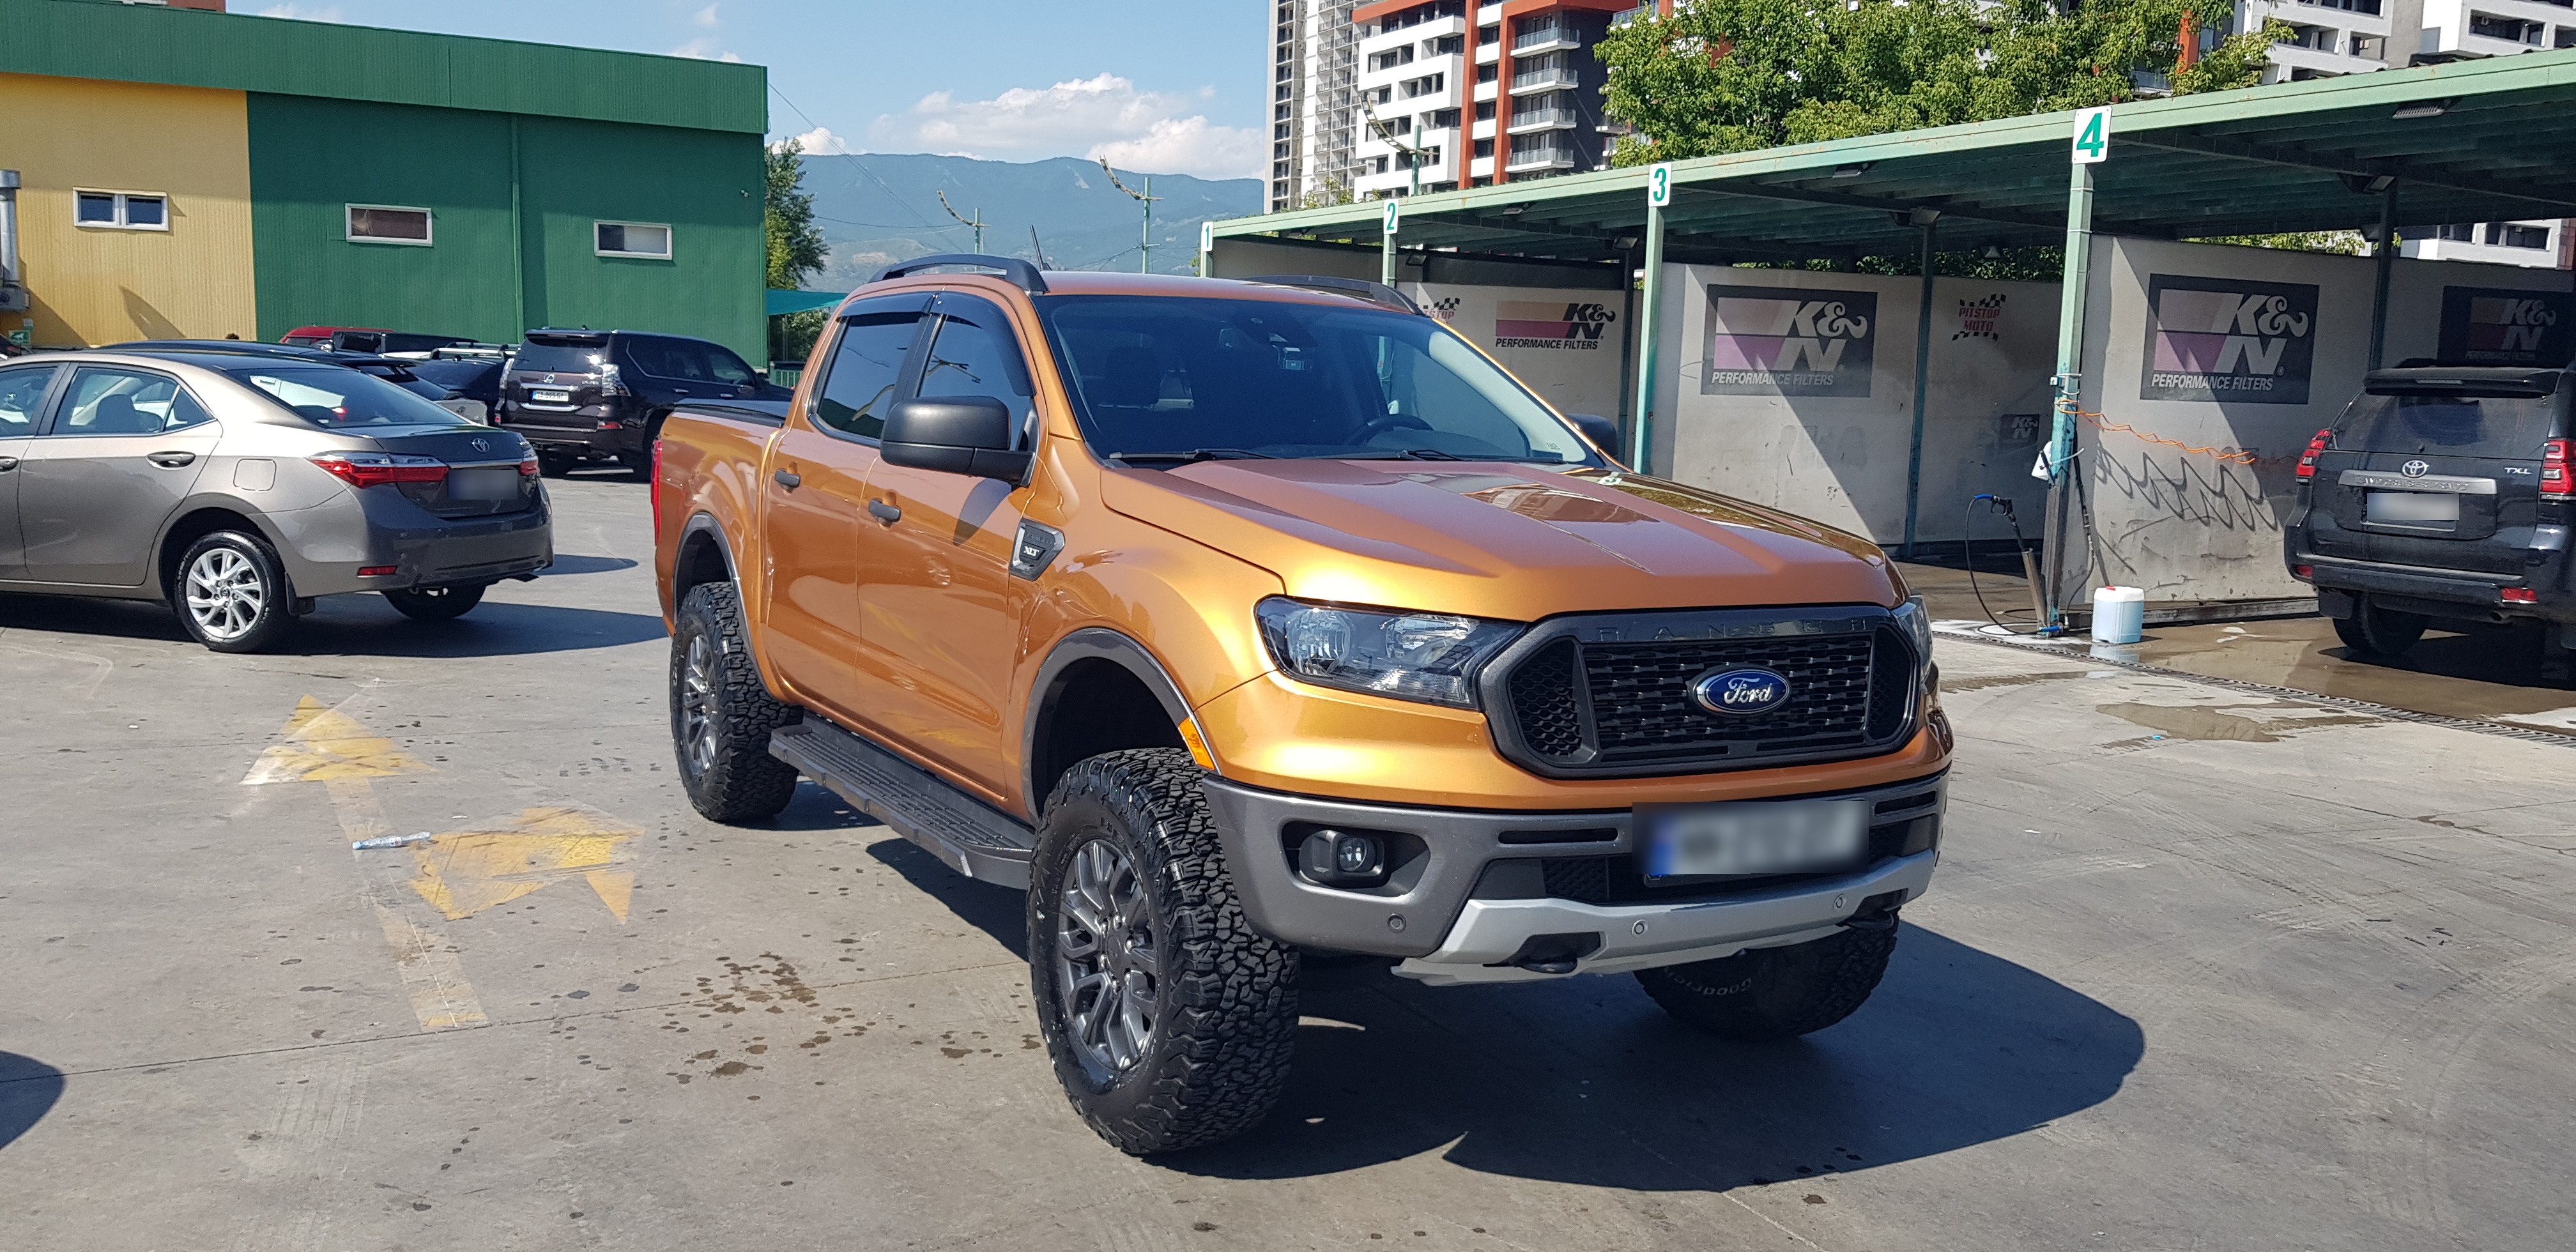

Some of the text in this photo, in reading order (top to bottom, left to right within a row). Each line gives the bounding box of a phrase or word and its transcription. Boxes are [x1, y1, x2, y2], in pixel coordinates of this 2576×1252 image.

[2076, 112, 2104, 157] 4
[1653, 168, 1667, 202] 3
[1387, 202, 1396, 231] 2
[1206, 225, 1209, 248] 1
[1958, 307, 2000, 318] PITSTOP
[1963, 320, 1994, 331] MOTO
[1496, 338, 1598, 350] PERFORMANCE FILTERS
[1712, 371, 1834, 386] PERFORMANCE FILTERS
[2151, 374, 2273, 391] PERFORMANCE FILTERS
[1023, 546, 1040, 556] XLT
[1724, 677, 1773, 704] Ford
